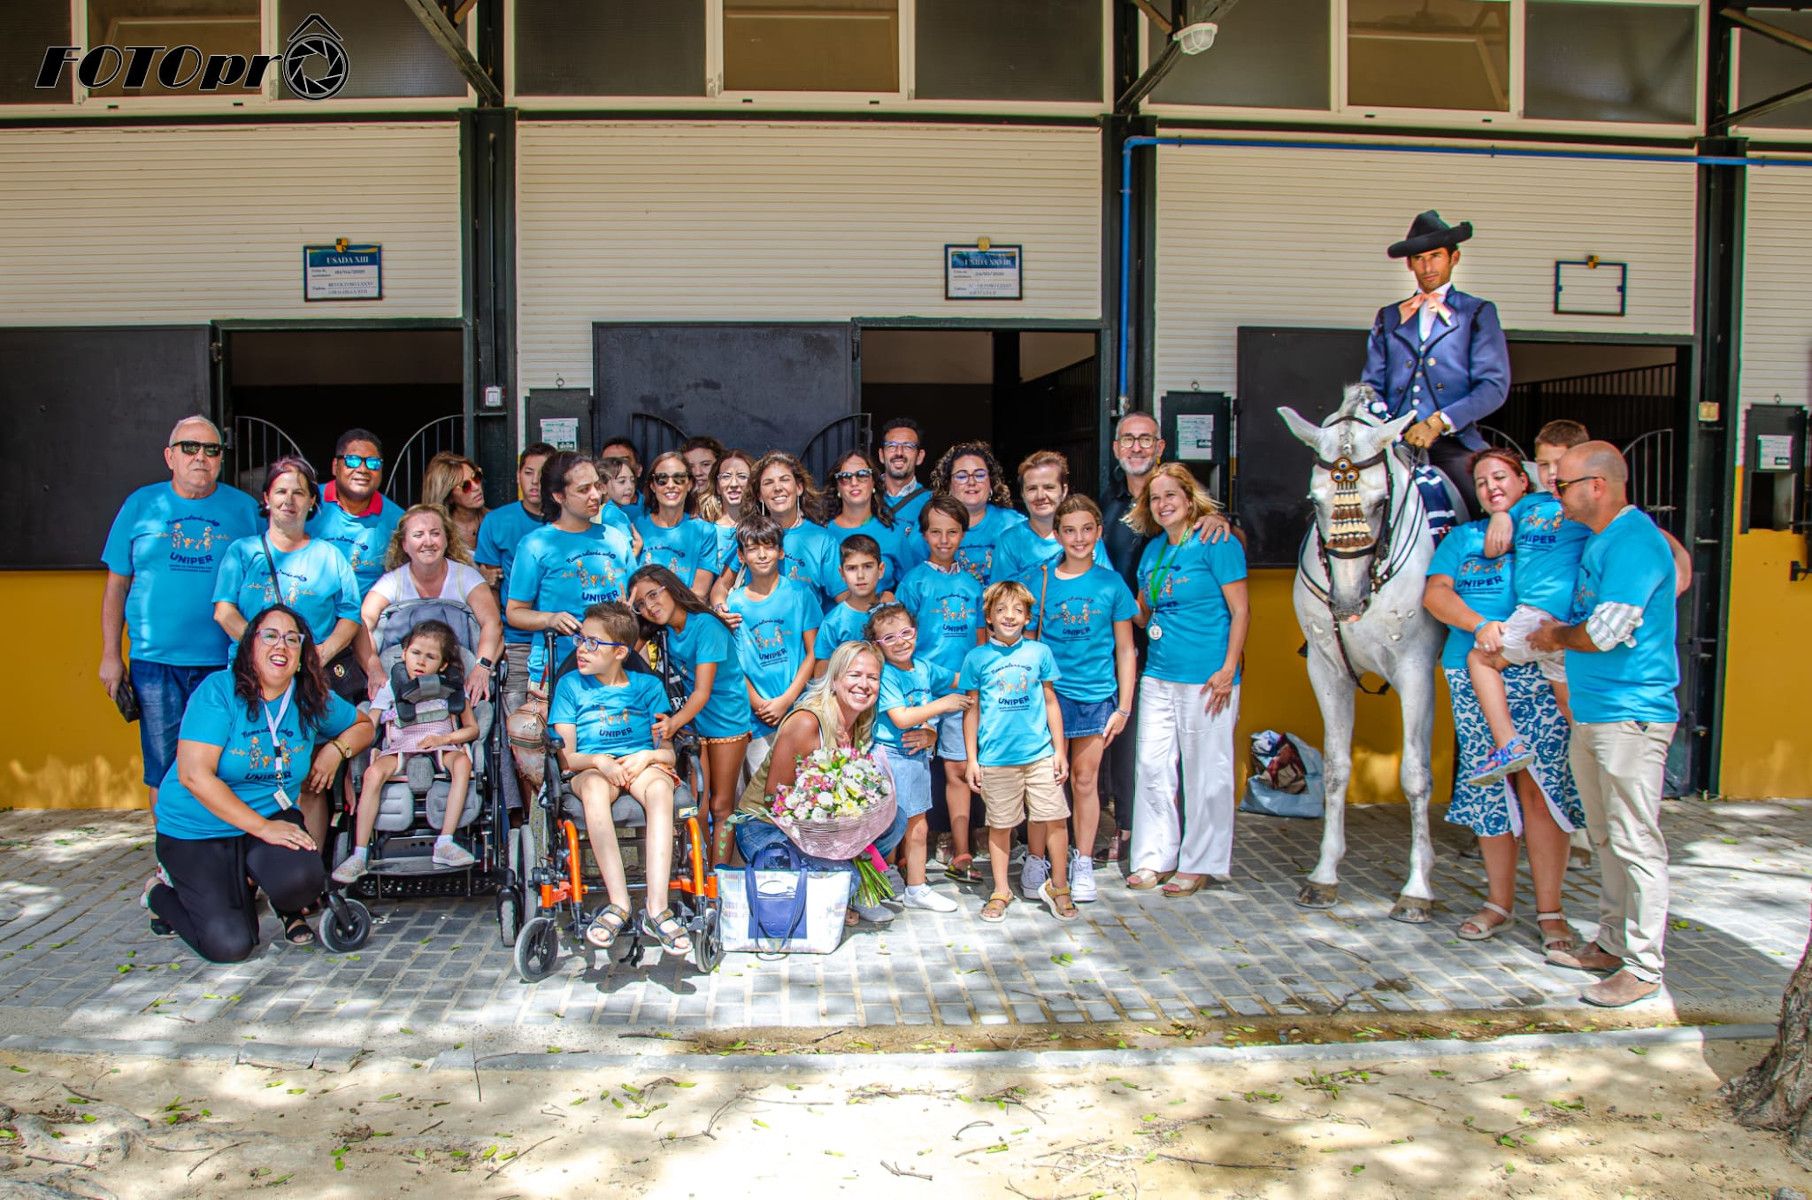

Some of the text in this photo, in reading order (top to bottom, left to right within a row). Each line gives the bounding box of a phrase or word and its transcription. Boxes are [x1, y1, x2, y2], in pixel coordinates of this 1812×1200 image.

[169, 552, 213, 564] UNIPER
[1456, 576, 1504, 588] UNIPER
[582, 590, 619, 601] UNIPER
[998, 695, 1031, 705] UNIPER
[599, 727, 633, 738] UNIPER
